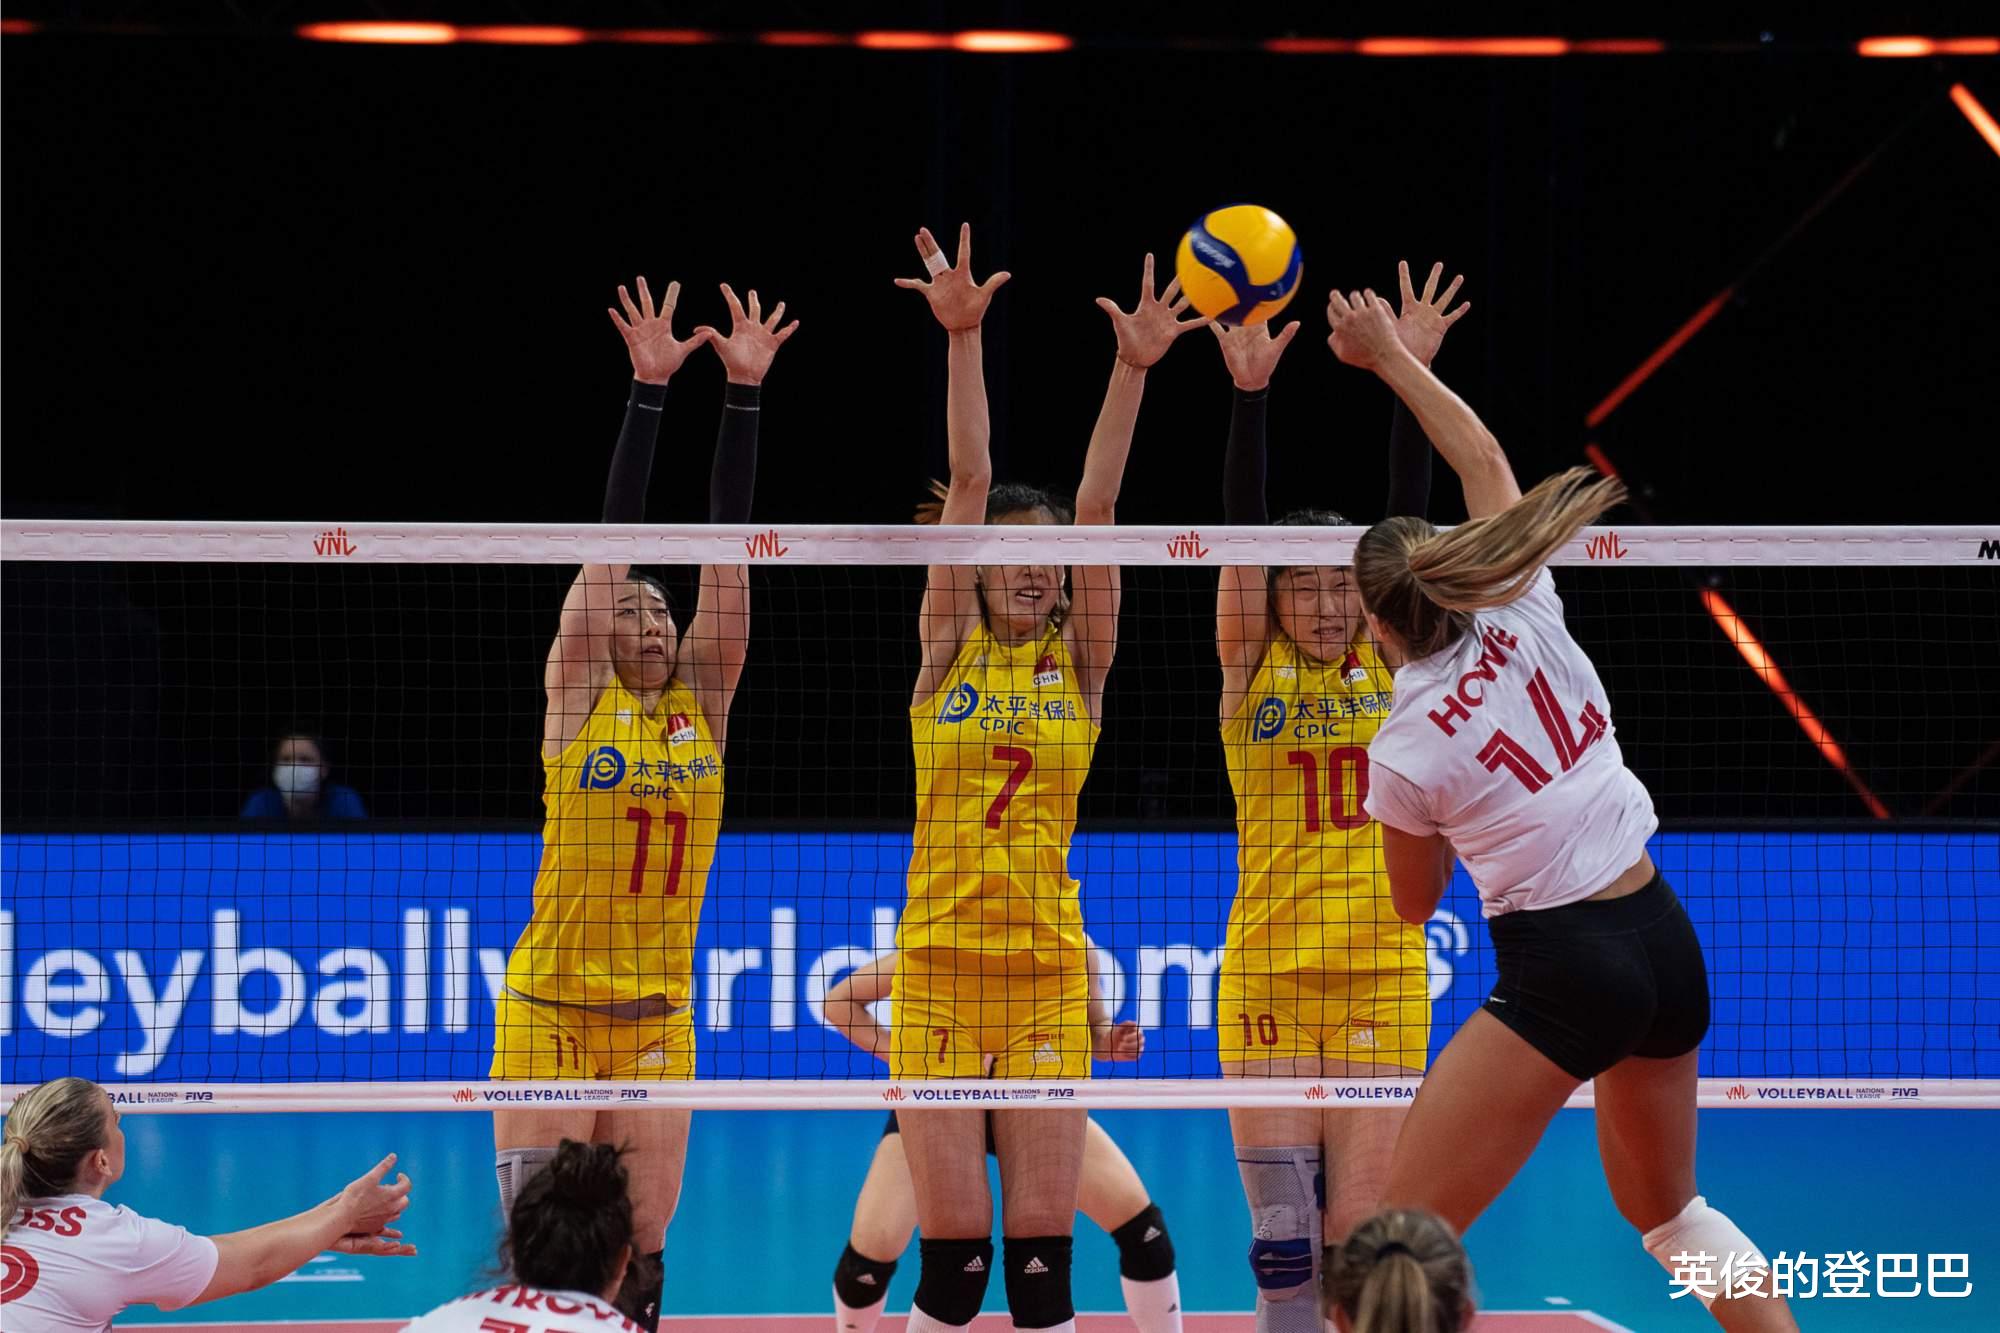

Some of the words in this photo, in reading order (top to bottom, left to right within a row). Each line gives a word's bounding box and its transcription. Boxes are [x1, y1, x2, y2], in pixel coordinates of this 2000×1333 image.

[1033, 672, 1060, 686] CHN
[1427, 625, 1519, 738] HOWE
[979, 717, 1026, 735] CPIC
[1294, 722, 1341, 739] CPIC
[1475, 666, 1608, 795] 14
[630, 783, 675, 801] CPIC
[985, 745, 1034, 830] 7
[1287, 746, 1371, 833] 10
[625, 806, 689, 896] 11
[1238, 1013, 1279, 1047] 10
[932, 1029, 949, 1064] 7
[484, 1090, 581, 1102] VOLLEYBALL
[912, 1089, 1009, 1100] VOLLEYBALL
[1757, 1088, 1853, 1099] VOLLEYBALL
